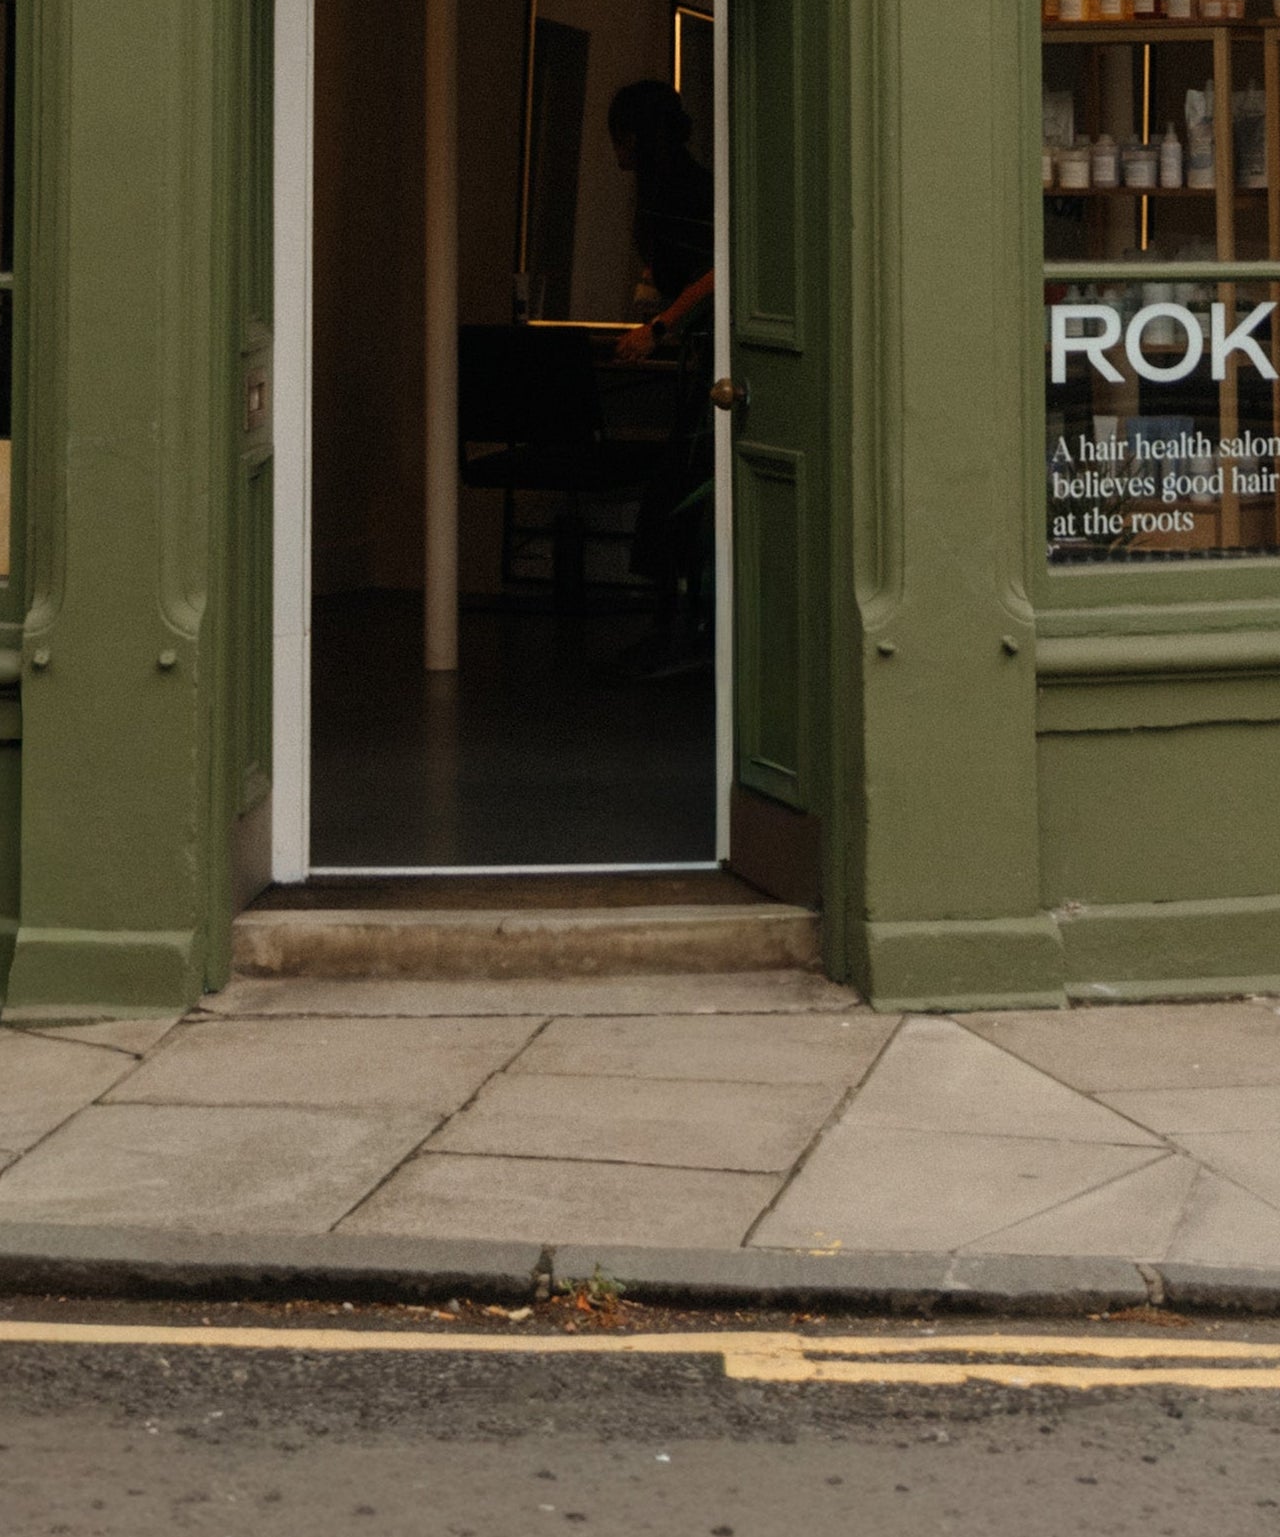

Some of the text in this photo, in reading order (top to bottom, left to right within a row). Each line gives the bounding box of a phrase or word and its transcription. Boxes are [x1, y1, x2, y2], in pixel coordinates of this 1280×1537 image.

[1052, 435, 1072, 462] A
[1079, 434, 1128, 462] hair
[1135, 430, 1212, 462] health
[1052, 471, 1156, 499] believes
[1161, 467, 1224, 503] good
[1231, 466, 1280, 494] hair
[1053, 507, 1194, 537] at the roots
